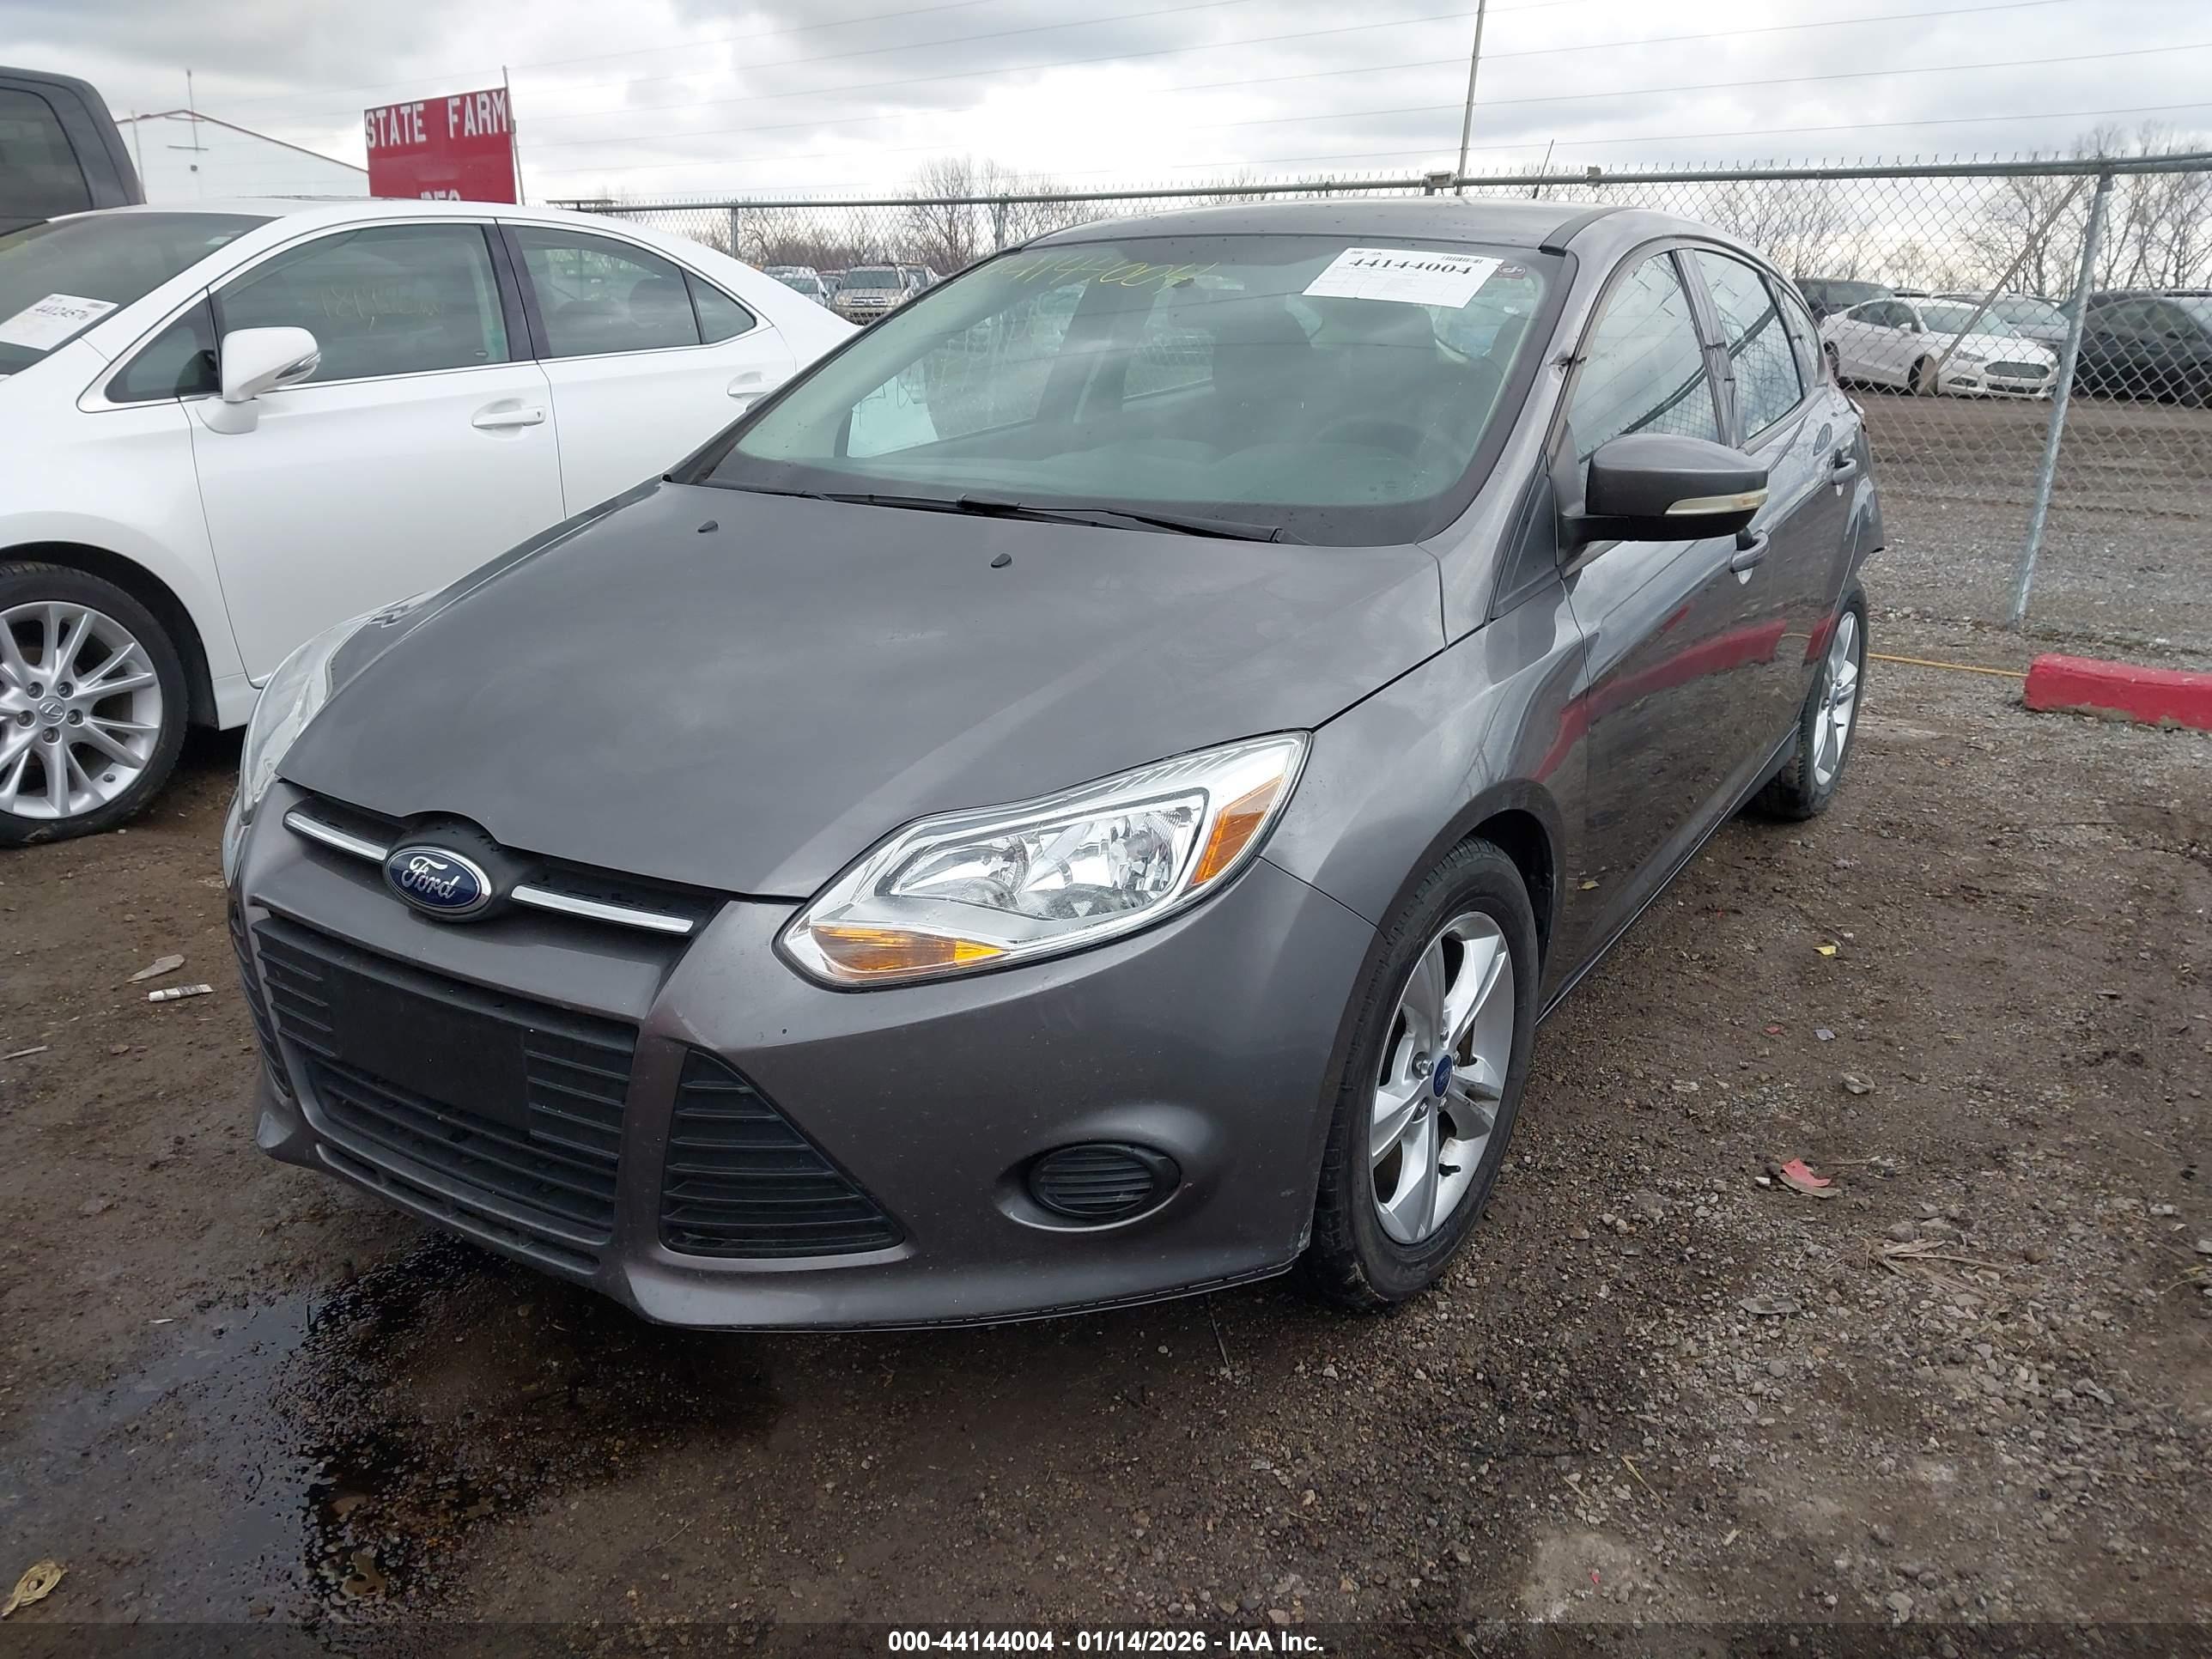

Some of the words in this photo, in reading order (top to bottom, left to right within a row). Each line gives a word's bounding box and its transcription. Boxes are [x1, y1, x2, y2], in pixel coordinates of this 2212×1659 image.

[365, 102, 427, 149] STATE
[447, 90, 507, 139] FARM
[1349, 258, 1473, 275] 44144004
[401, 856, 460, 899] Ford
